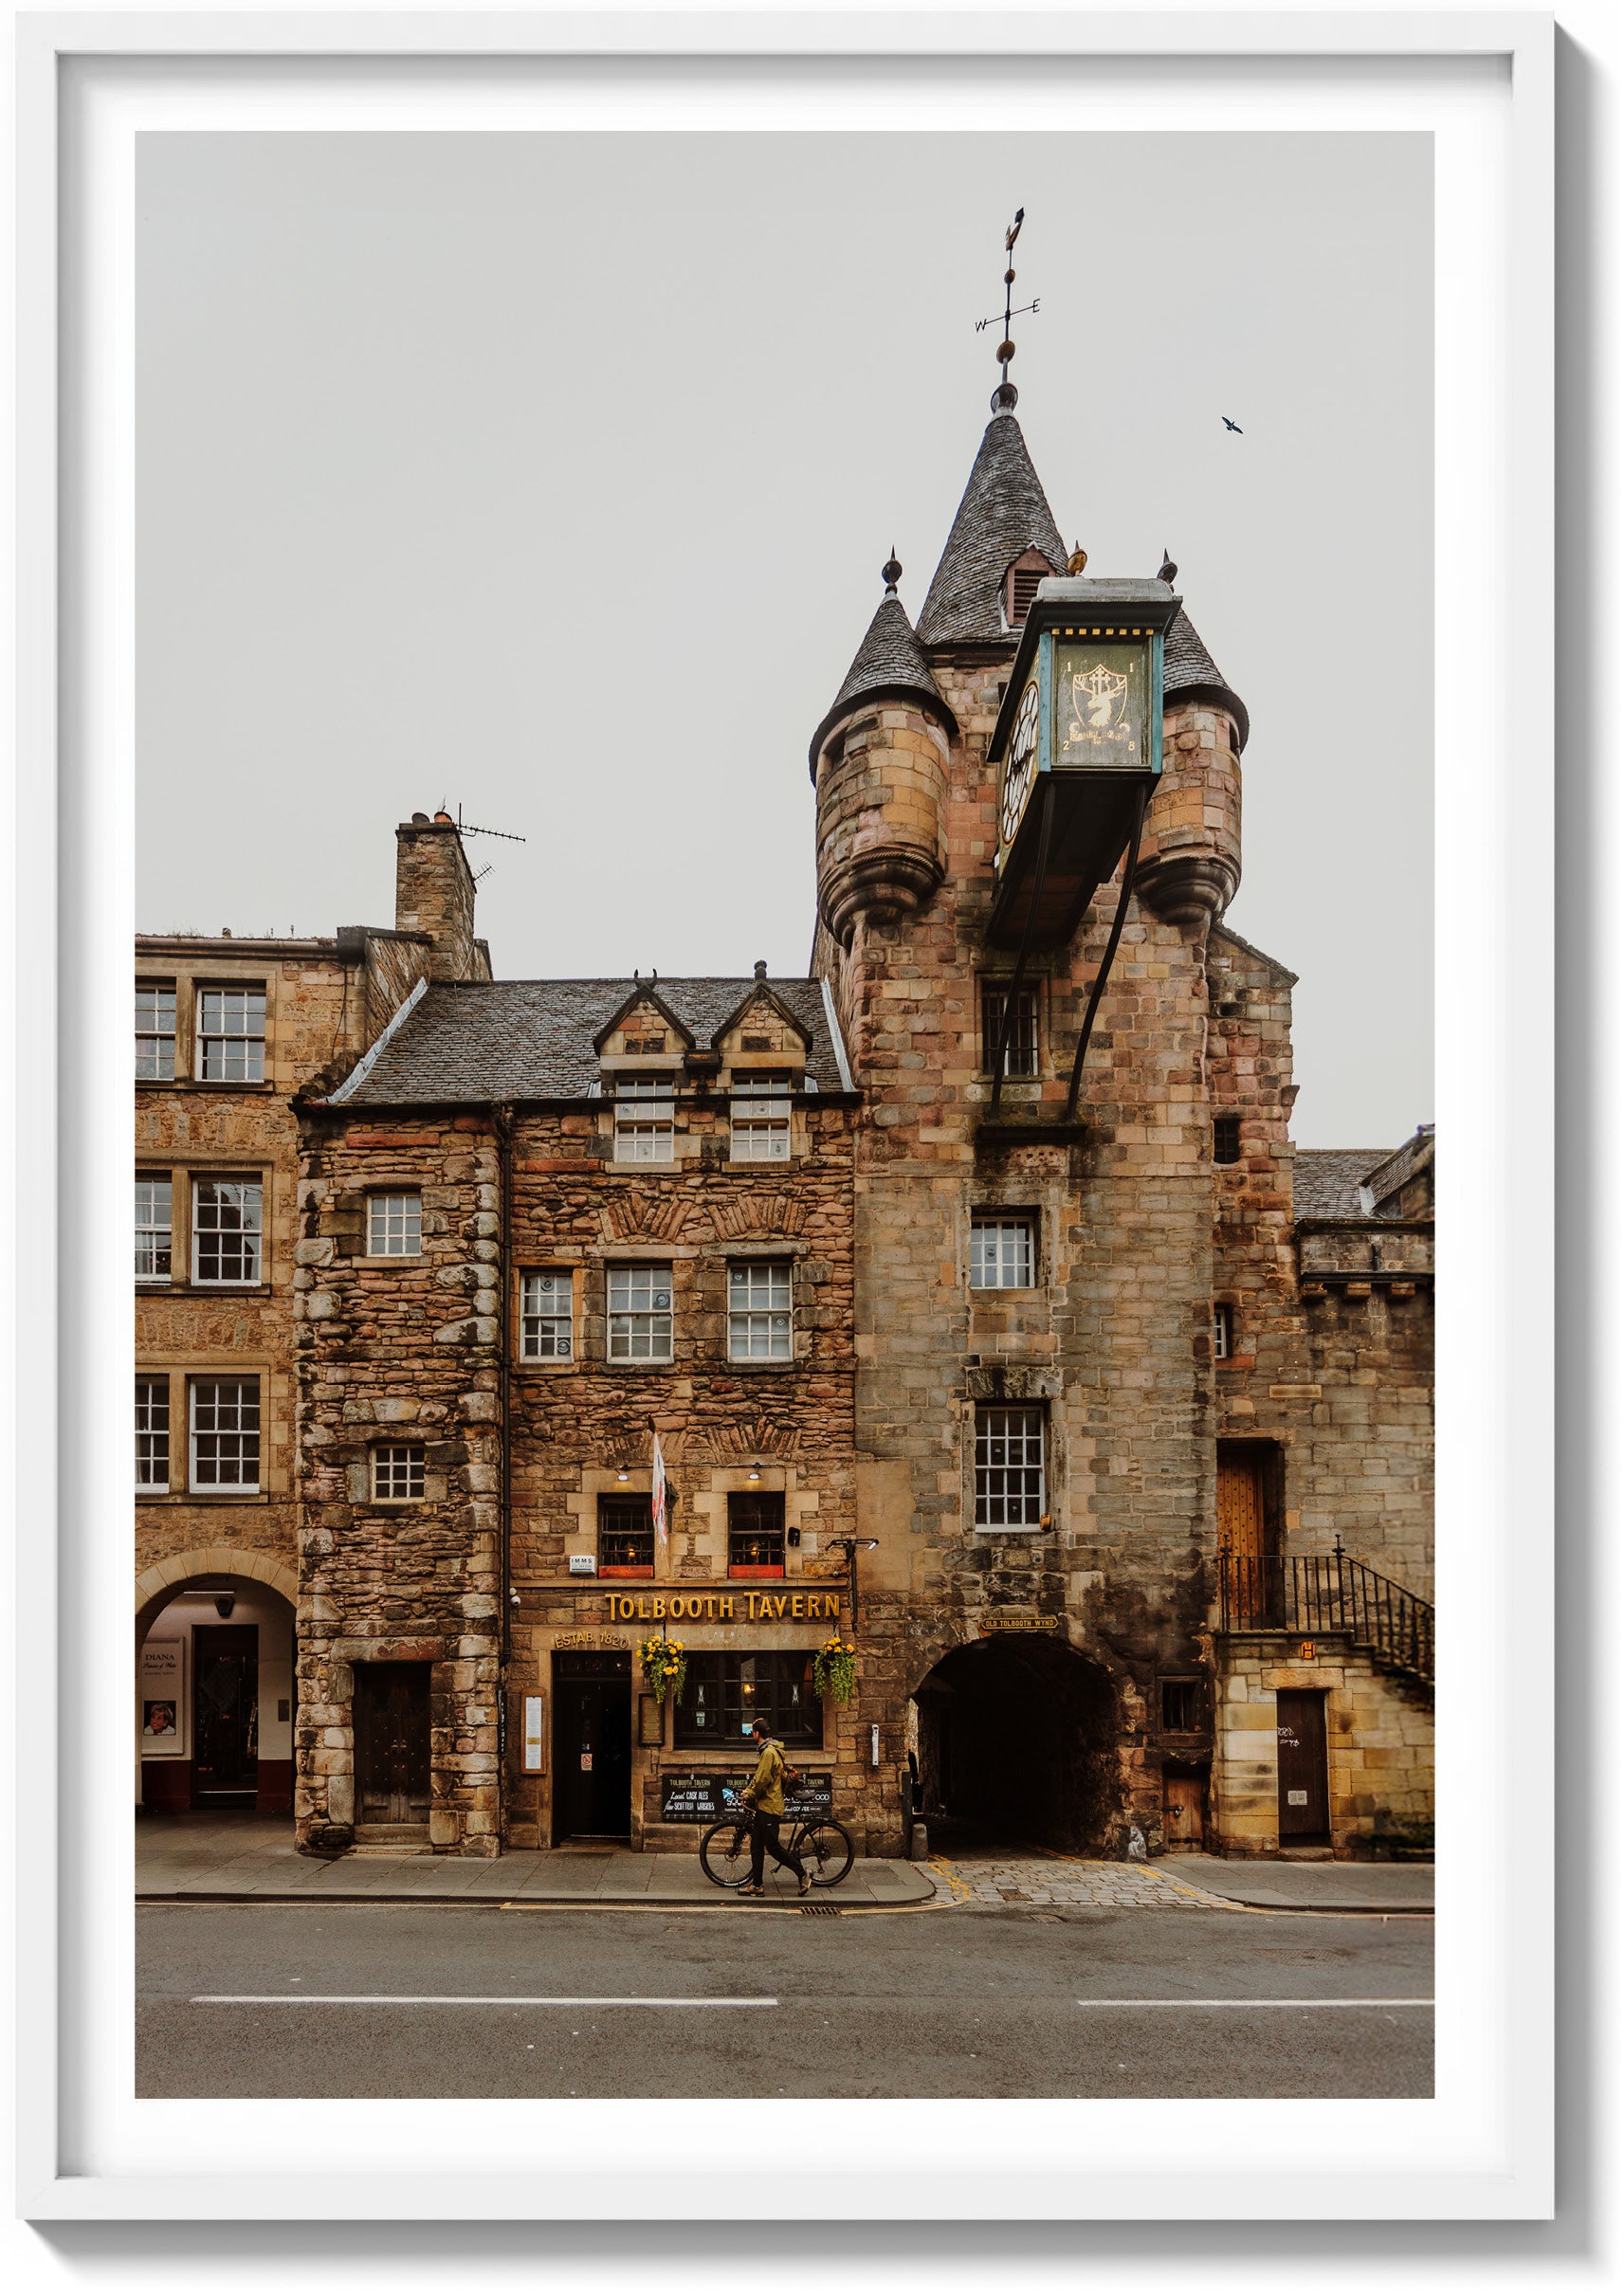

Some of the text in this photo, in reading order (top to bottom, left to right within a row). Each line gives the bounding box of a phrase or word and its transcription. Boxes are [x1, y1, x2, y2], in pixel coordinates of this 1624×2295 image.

[1032, 298, 1041, 314] E
[975, 319, 987, 333] W
[1067, 662, 1134, 672] 1 1
[1063, 740, 1135, 751] 2 8
[605, 1592, 840, 1621] TOLBOOTH TAVERN
[555, 1630, 629, 1648] ESTAB. 1820
